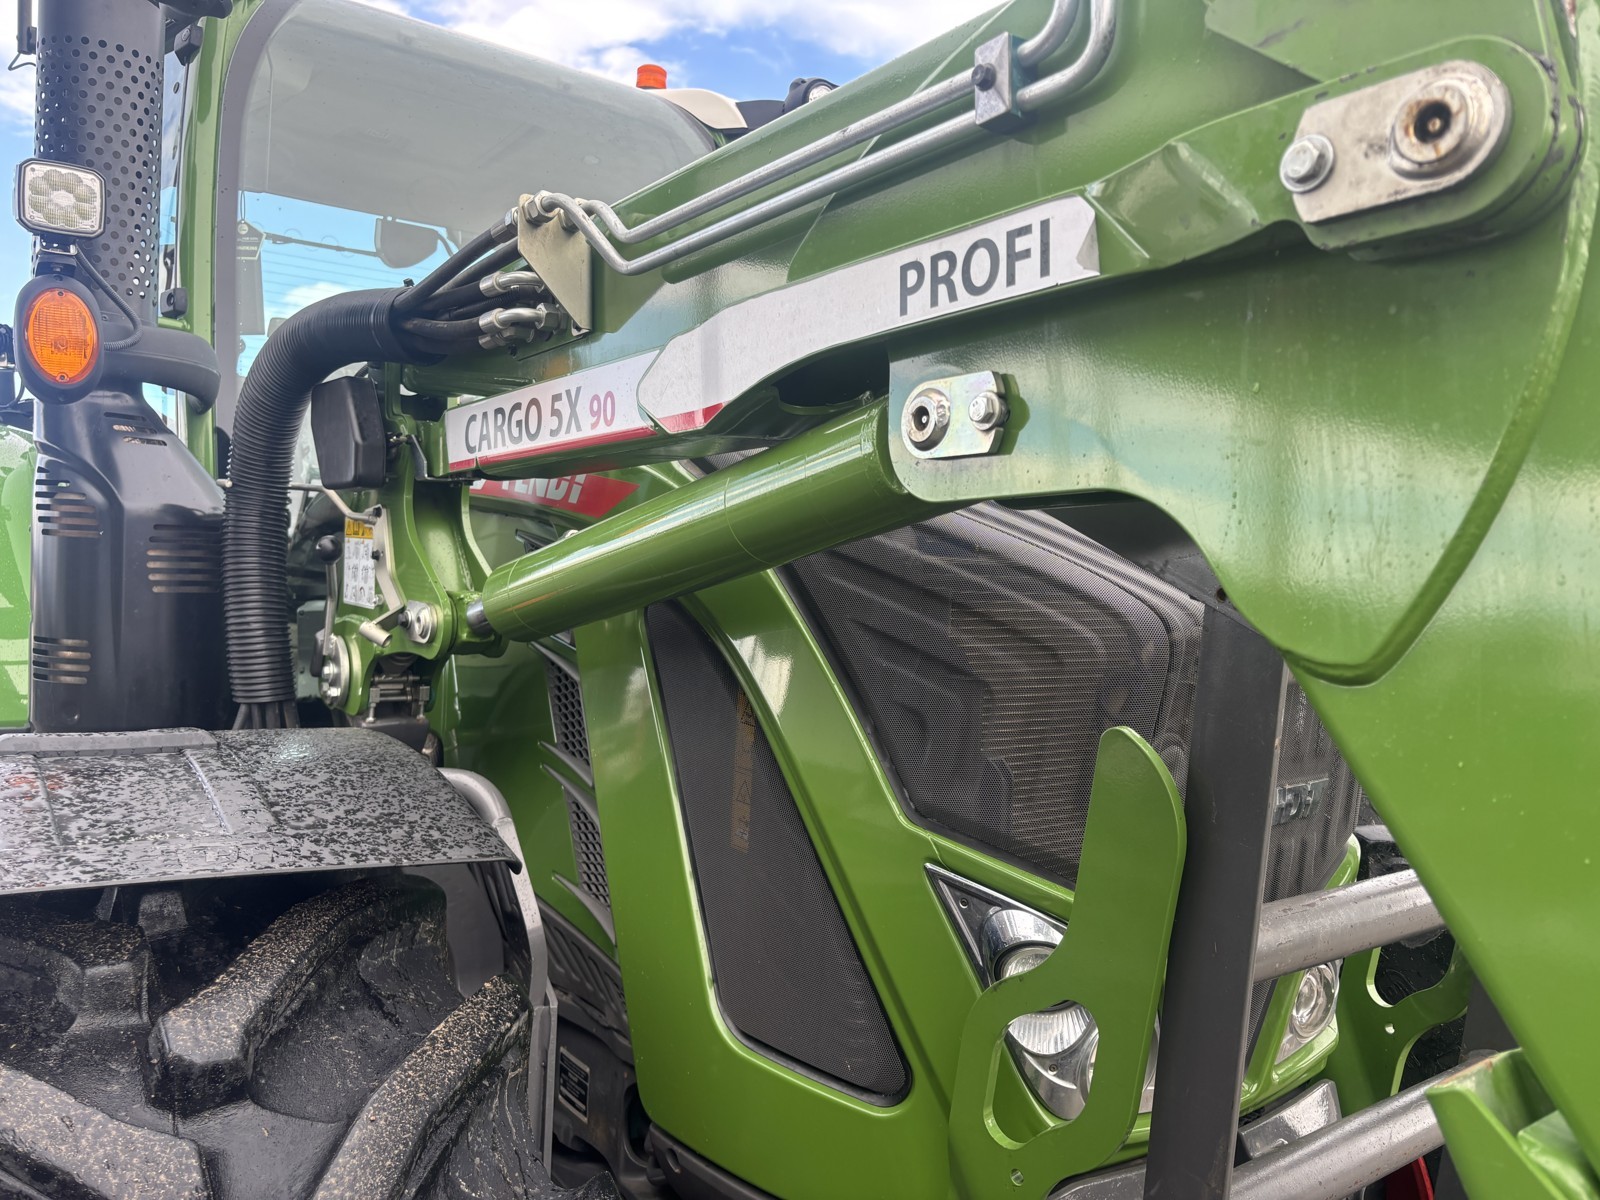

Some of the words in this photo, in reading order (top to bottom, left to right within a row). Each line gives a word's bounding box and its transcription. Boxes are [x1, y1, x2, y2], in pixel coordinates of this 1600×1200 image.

[900, 218, 1050, 317] PROFI
[465, 397, 543, 454] CARGO
[550, 386, 583, 437] 5X
[589, 391, 616, 430] 90
